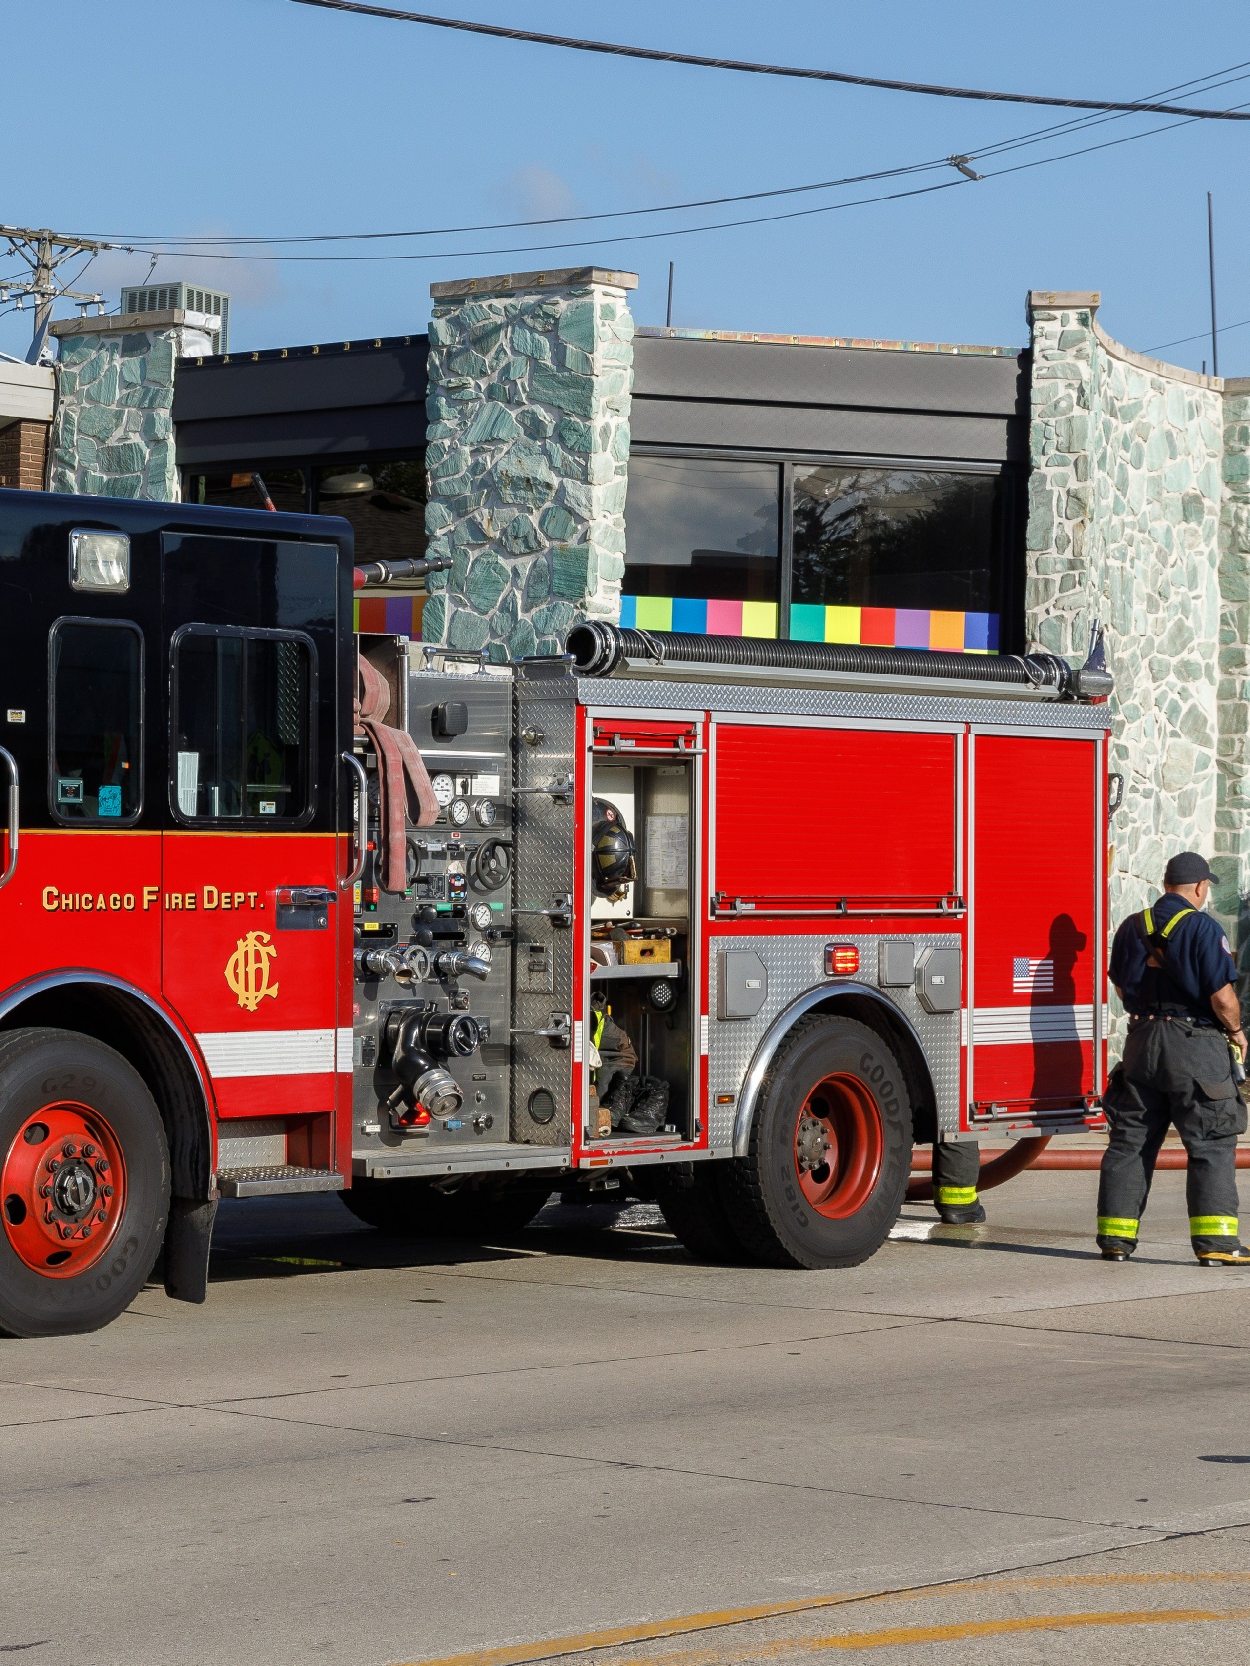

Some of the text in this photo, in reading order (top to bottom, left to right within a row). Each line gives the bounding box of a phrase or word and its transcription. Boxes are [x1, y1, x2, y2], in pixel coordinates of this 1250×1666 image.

[41, 885, 266, 912] CHICAGO FIRE DEPT.
